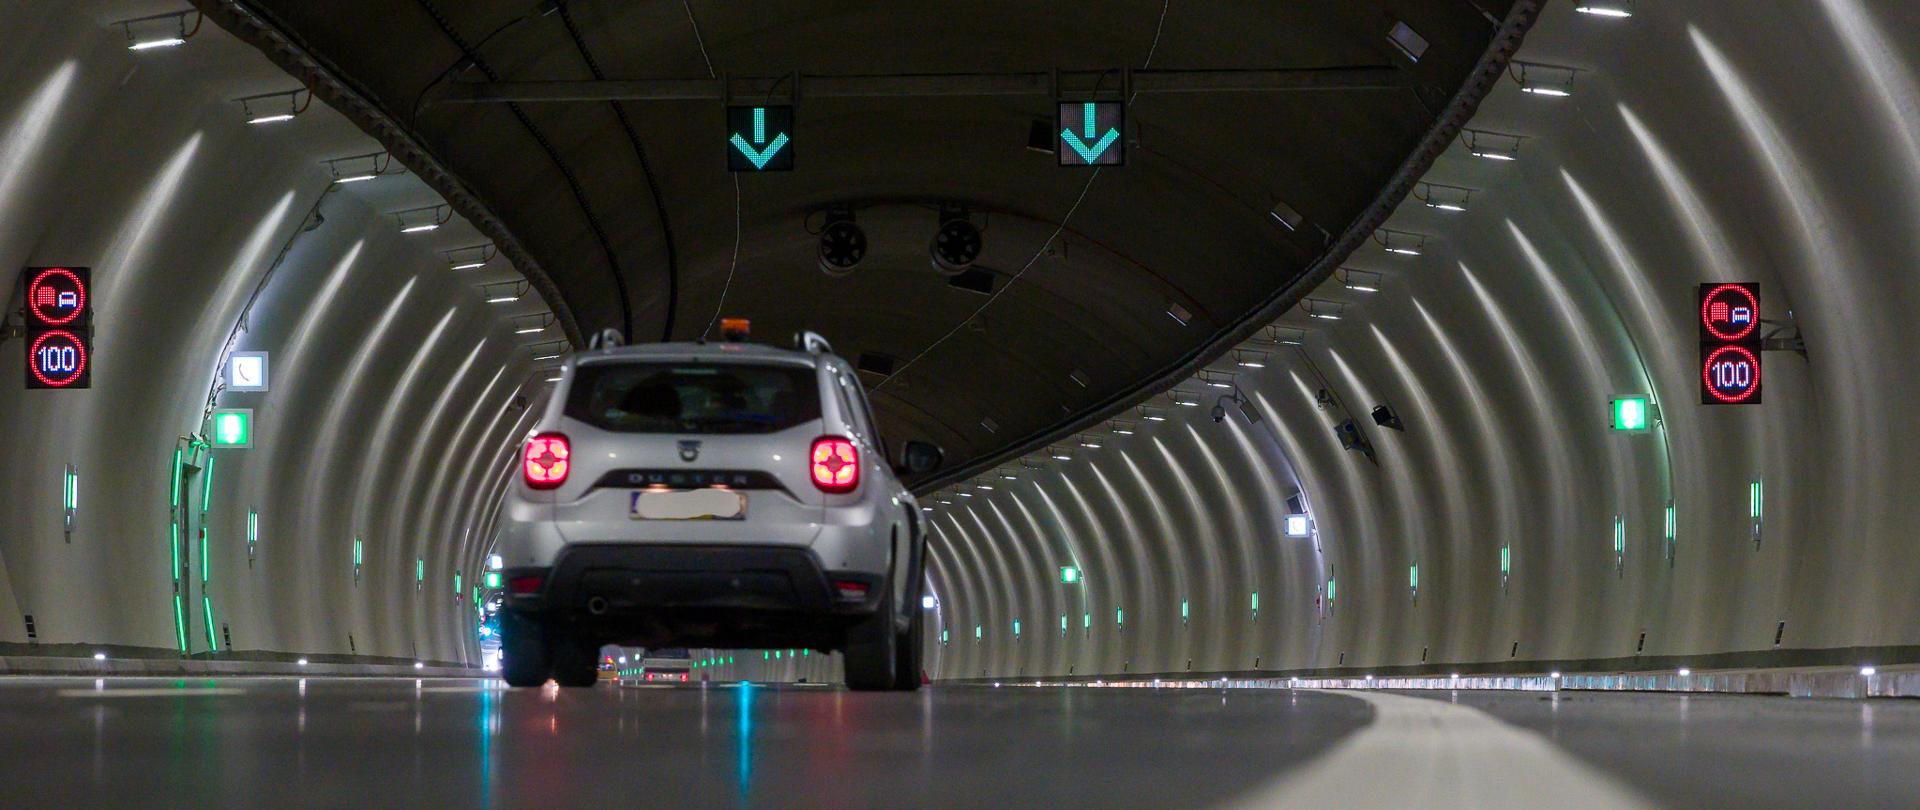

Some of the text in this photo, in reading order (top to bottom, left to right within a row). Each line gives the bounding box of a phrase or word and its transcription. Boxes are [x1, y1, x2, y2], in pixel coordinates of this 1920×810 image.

[38, 346, 74, 371] 100
[1712, 361, 1749, 387] 100
[628, 473, 747, 485] DUSTER
